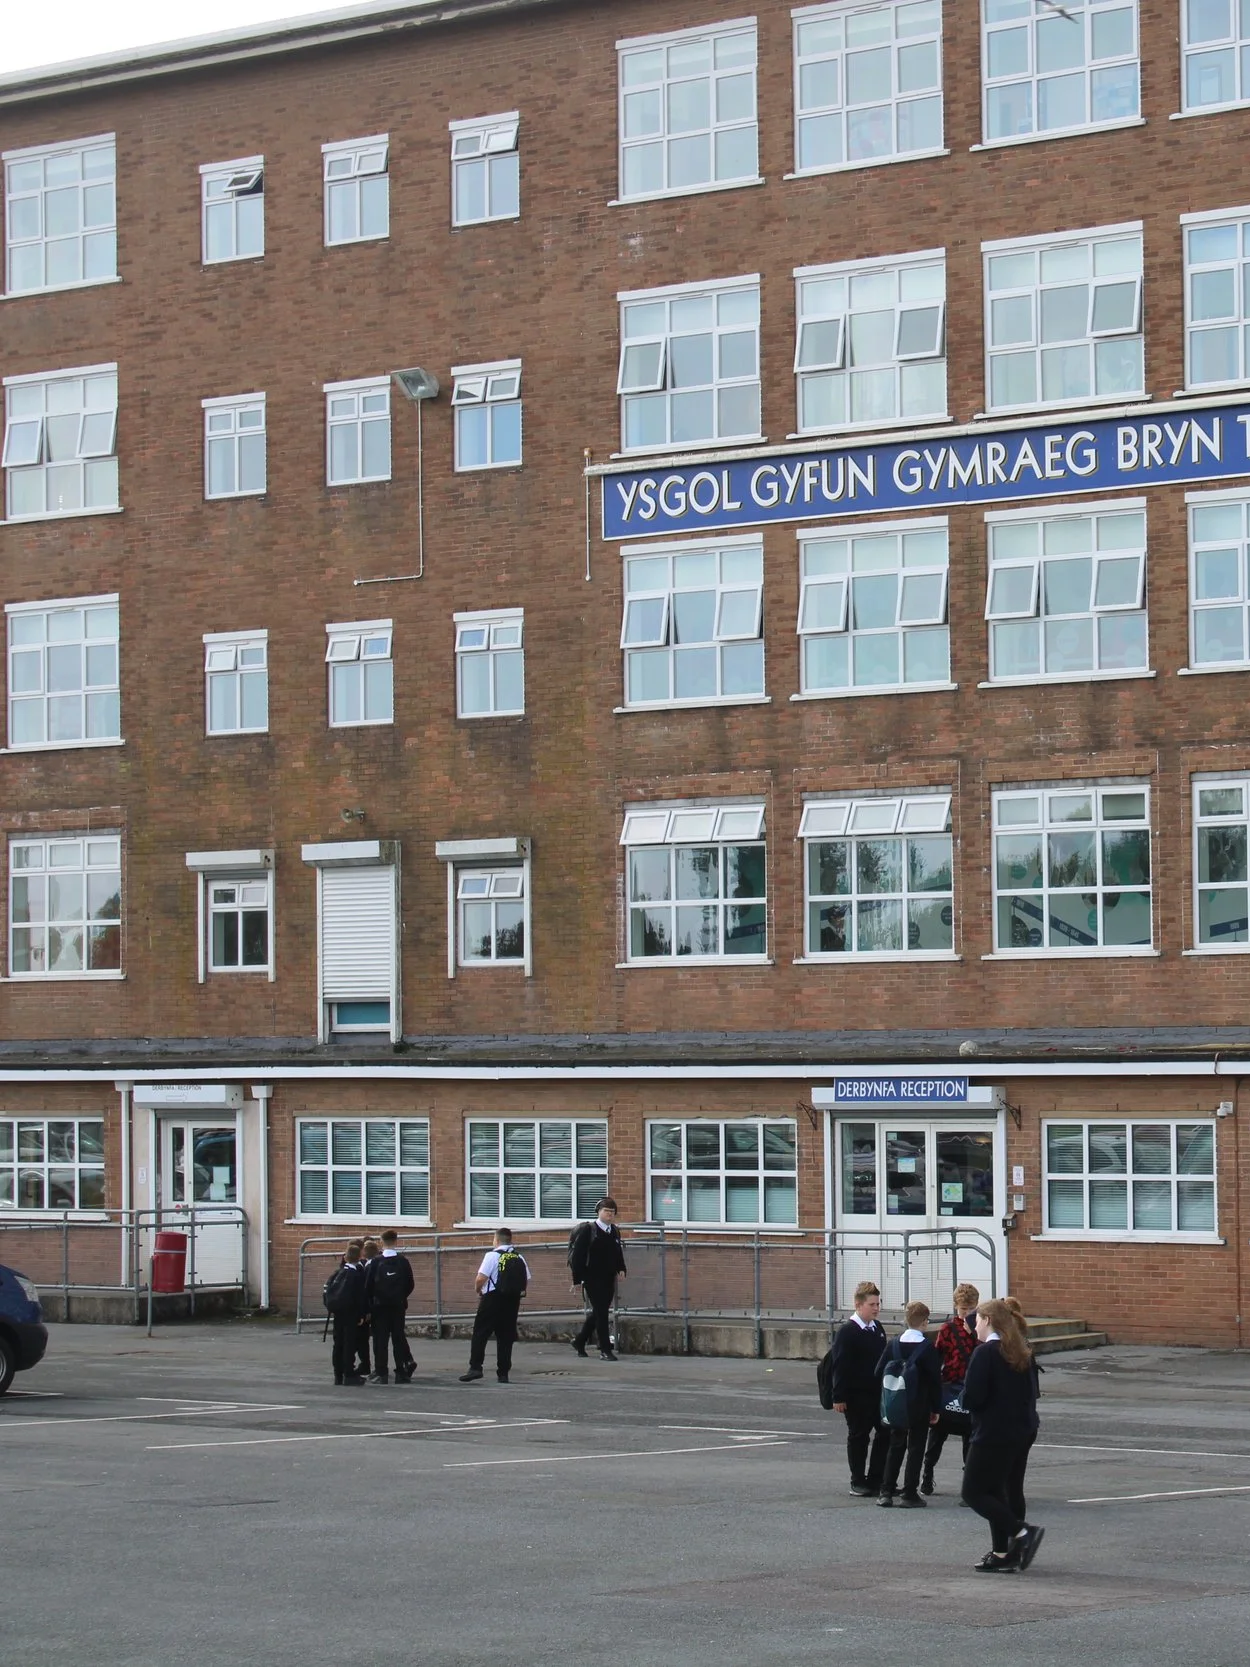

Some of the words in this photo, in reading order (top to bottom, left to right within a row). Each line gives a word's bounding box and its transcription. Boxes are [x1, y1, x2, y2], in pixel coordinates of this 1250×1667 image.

[617, 469, 742, 521] YSGOL
[750, 454, 875, 507] GYFUN
[893, 430, 1098, 492] GYMRAEG
[1117, 416, 1222, 469] BRYN
[838, 1081, 896, 1097] DERBYNFA
[901, 1080, 965, 1097] RECEPTION
